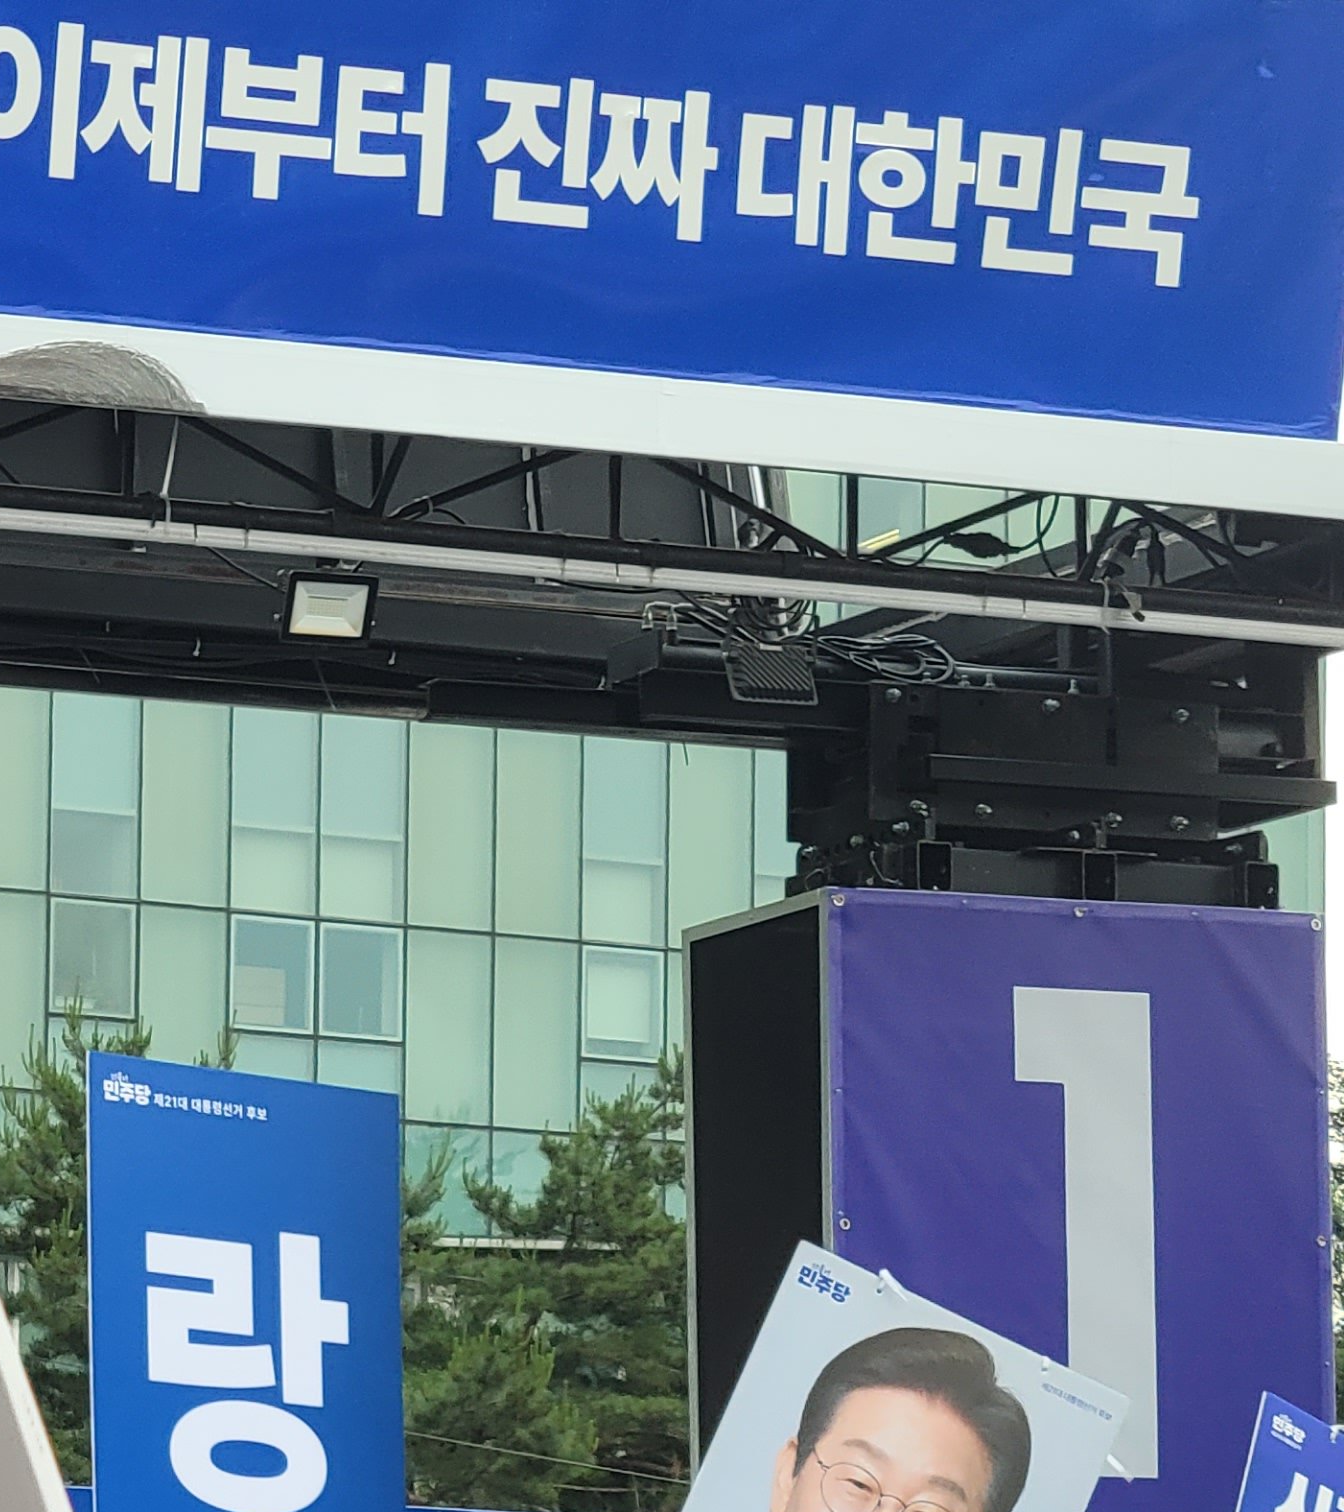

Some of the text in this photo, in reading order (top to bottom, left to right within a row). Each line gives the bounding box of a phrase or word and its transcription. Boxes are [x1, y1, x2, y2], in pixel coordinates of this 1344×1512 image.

[477, 78, 716, 242] 진짜
[736, 102, 1200, 289] 대한민국
[103, 1079, 267, 1121] 민주당 제21대 대통령선거 후보
[799, 1265, 851, 1304] 민주당
[1013, 986, 1158, 1479] 1
